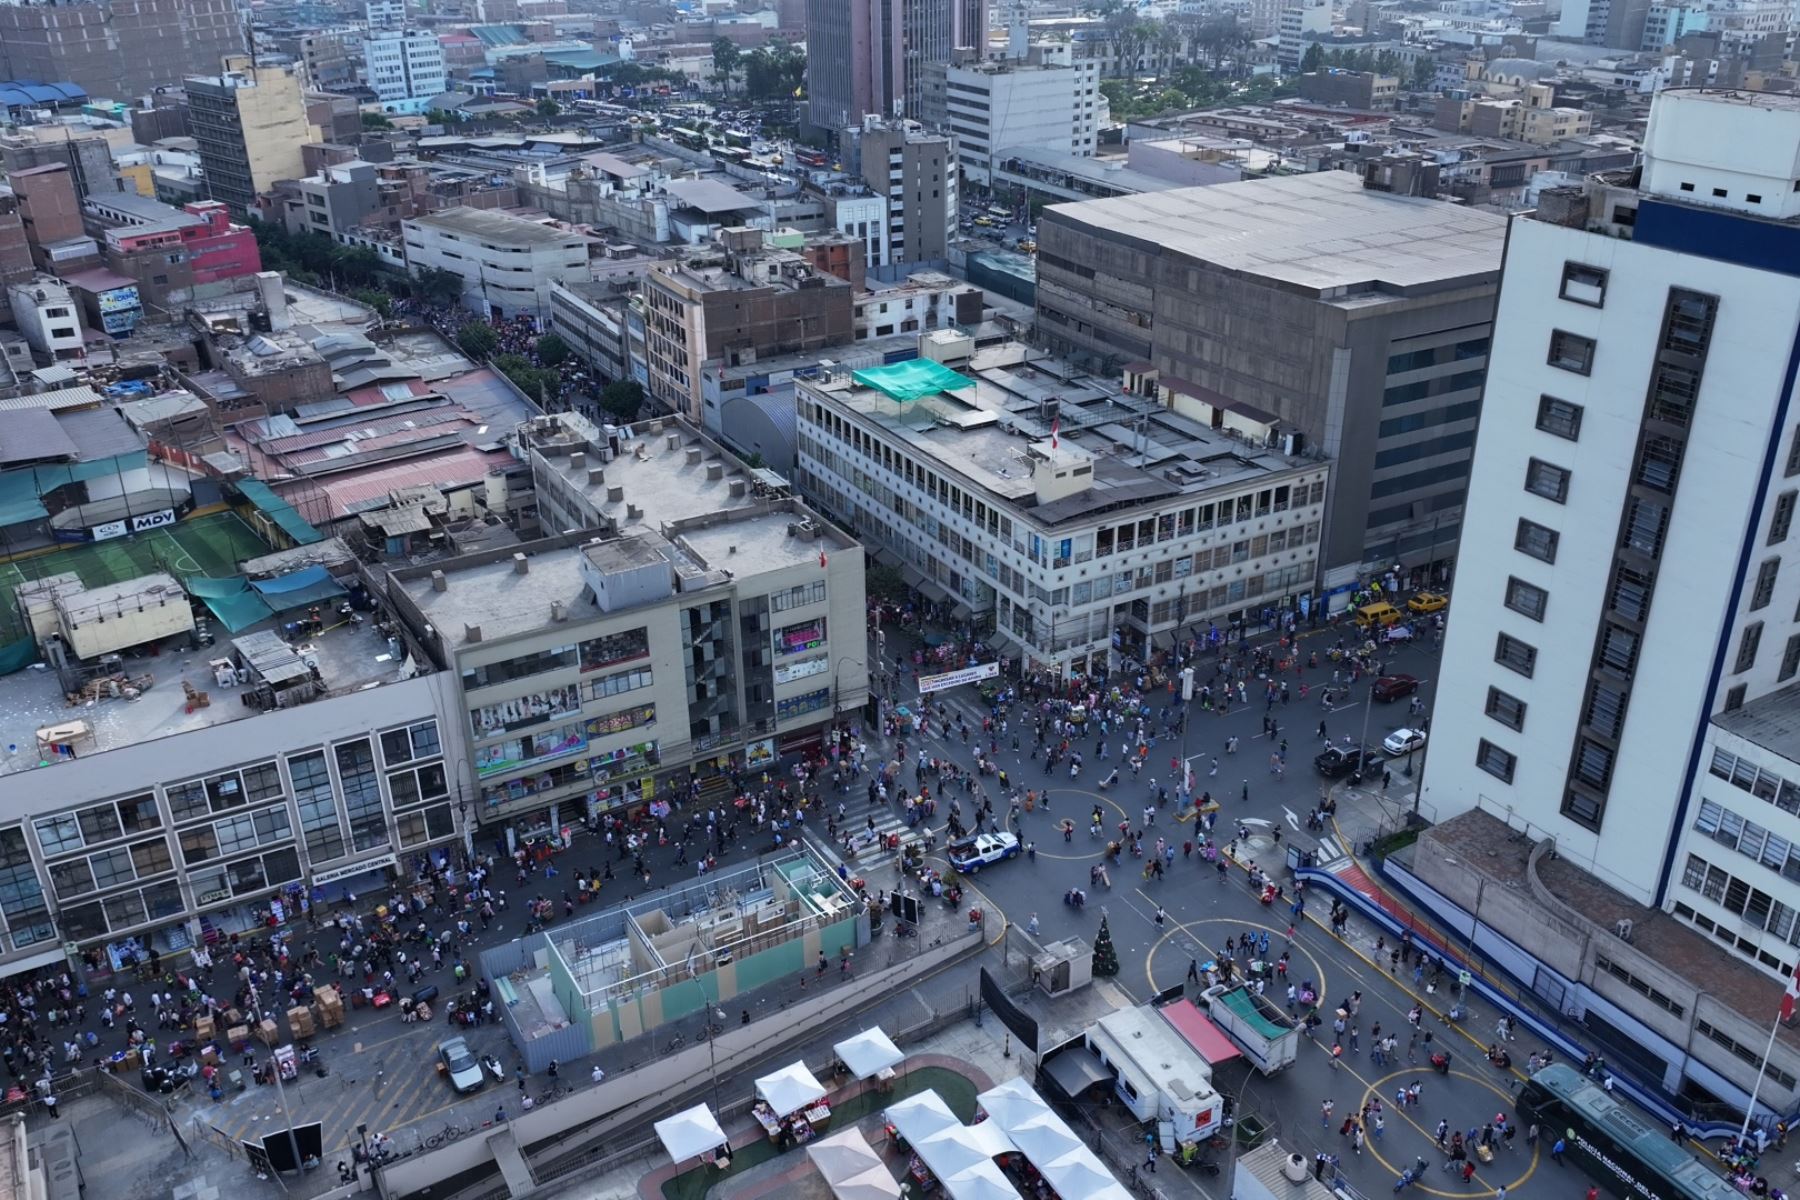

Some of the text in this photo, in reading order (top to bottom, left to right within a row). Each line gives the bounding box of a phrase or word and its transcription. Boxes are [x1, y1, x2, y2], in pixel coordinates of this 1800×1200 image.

[136, 513, 172, 529] MDV
[340, 864, 367, 876] MERCADO
[367, 857, 392, 868] CENTRAL
[1602, 1155, 1636, 1184] NACIONAL
